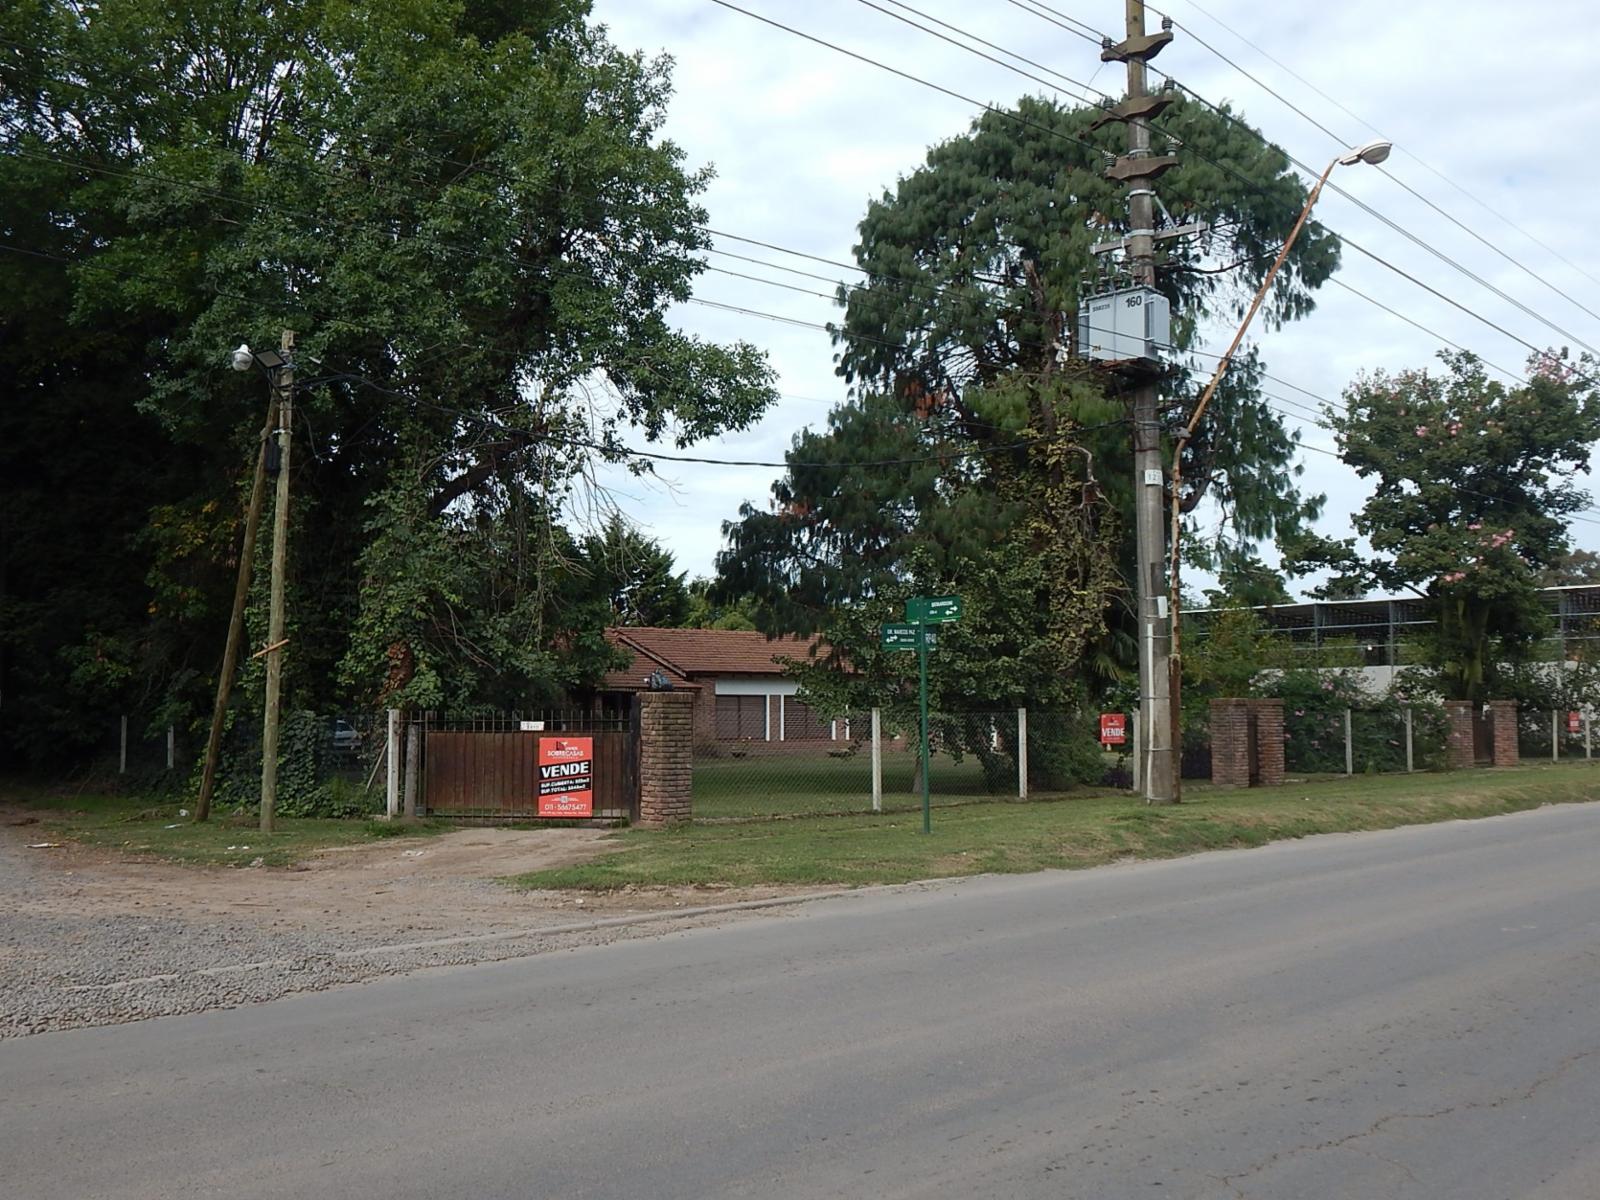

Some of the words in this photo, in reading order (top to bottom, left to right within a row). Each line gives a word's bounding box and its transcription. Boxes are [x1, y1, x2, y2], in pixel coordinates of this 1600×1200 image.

[1125, 296, 1142, 308] 160
[1102, 728, 1125, 737] VENDE
[541, 762, 589, 778] VENDE
